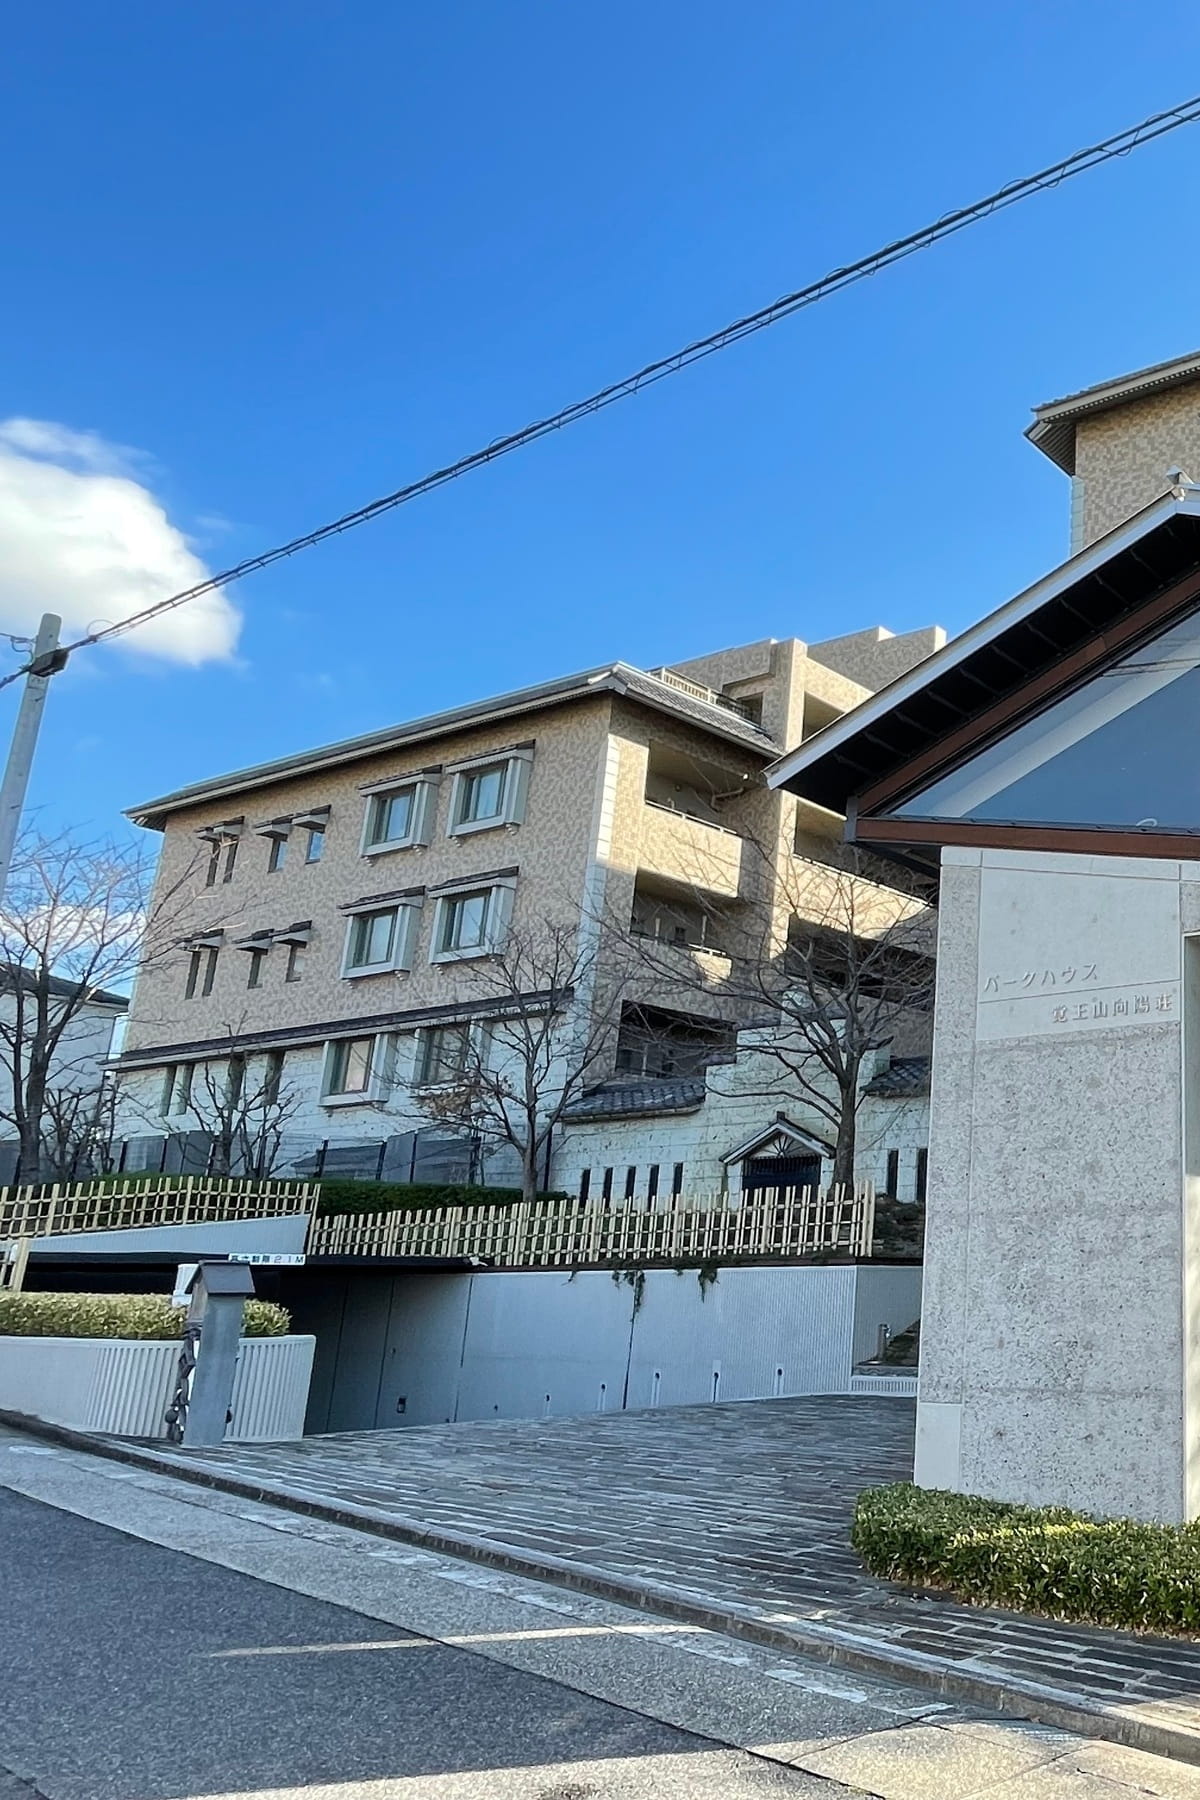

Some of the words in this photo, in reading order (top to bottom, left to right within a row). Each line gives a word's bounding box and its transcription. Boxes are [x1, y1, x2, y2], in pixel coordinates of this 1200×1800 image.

[983, 962, 1097, 993] パークハウス
[1052, 994, 1173, 1024] 覚王山向陽荘
